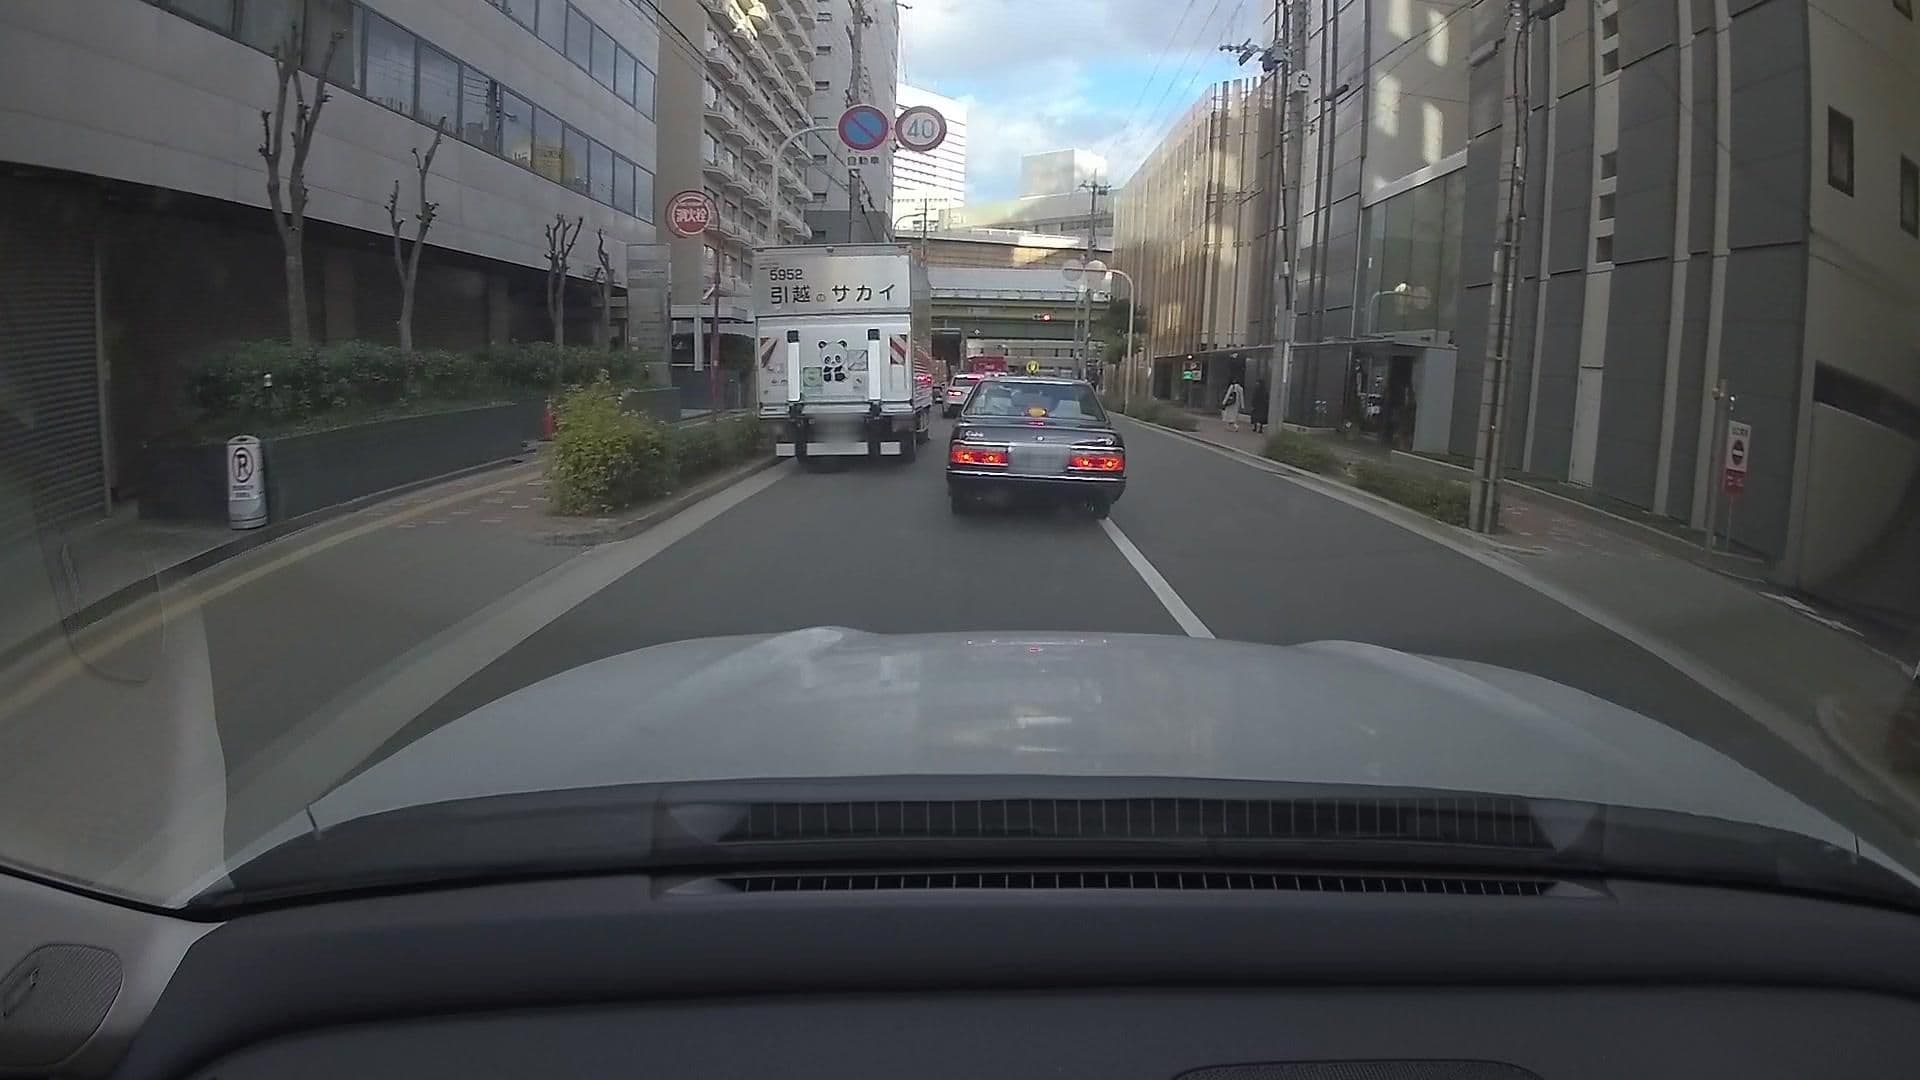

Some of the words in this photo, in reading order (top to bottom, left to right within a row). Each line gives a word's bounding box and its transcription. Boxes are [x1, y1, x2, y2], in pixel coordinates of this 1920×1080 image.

[907, 119, 934, 138] 40
[676, 208, 707, 222] 消火栓
[770, 269, 803, 281] 5952
